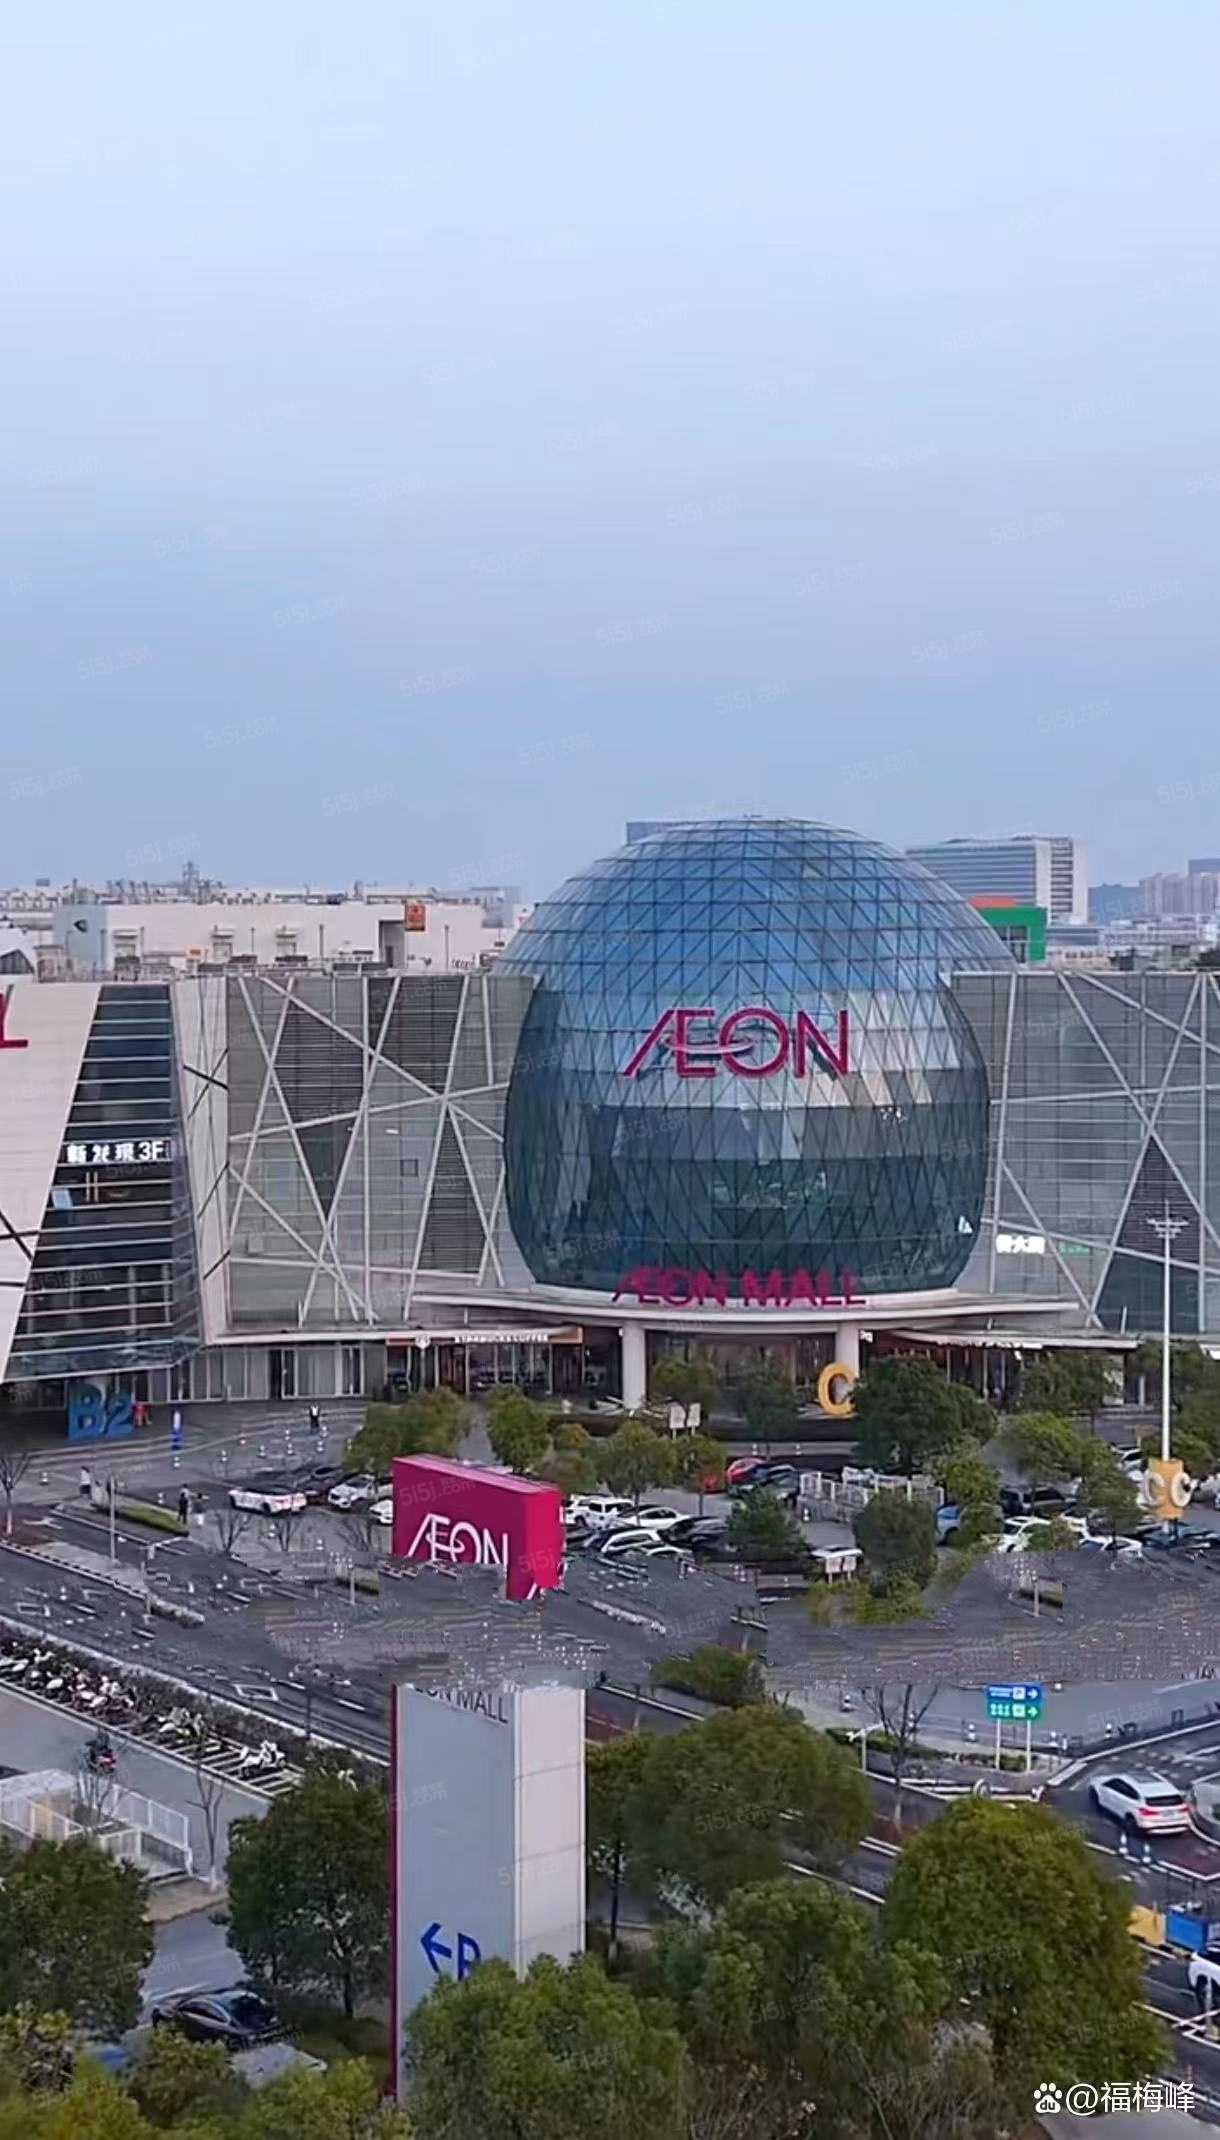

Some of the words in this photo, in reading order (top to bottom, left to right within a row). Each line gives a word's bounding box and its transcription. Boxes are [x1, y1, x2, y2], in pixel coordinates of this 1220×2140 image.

[740, 1267, 867, 1307] MALL
[68, 1382, 135, 1440] B2
[457, 1932, 481, 1981] P
